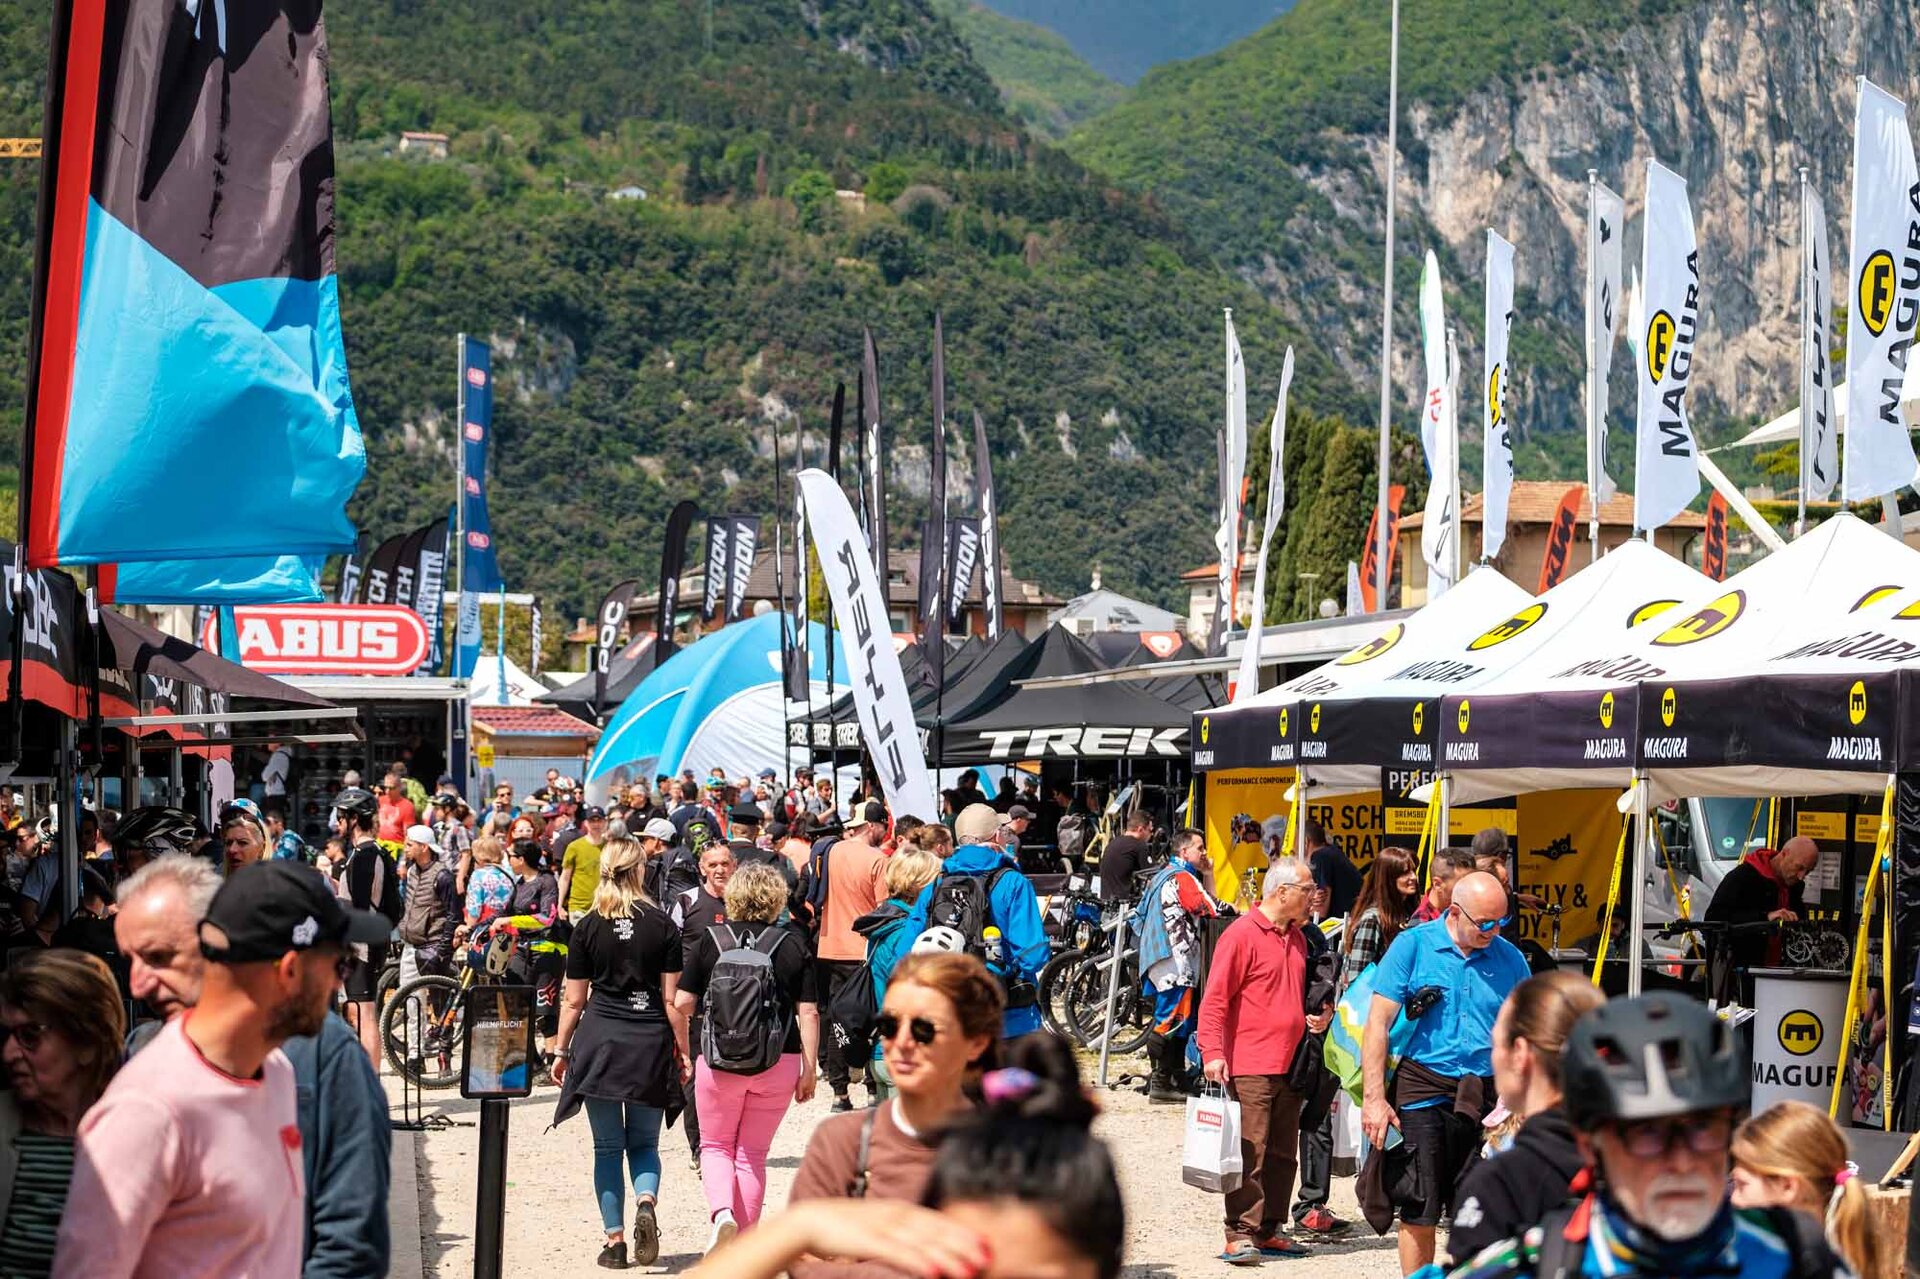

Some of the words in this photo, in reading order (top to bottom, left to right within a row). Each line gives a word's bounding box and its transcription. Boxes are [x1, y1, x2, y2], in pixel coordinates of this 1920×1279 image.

[1658, 249, 1699, 458] MAGURA
[1546, 506, 1575, 590] KTM
[240, 618, 399, 660] ABUS
[598, 600, 625, 675] POC
[1384, 660, 1485, 684] MAGURA
[1548, 654, 1666, 682] MAGUR
[836, 722, 860, 747] TREK
[979, 726, 1190, 758] TREK
[1194, 750, 1214, 766] MAGURA
[1271, 743, 1294, 762] MAGURA
[1301, 741, 1327, 758] MAGURA
[1402, 743, 1431, 761] MAGURA
[1446, 742, 1479, 761] MAGURA
[1584, 737, 1626, 760] MAGURA
[1643, 736, 1687, 760] MAGURA
[1826, 736, 1882, 761] MAGURA
[1216, 777, 1259, 786] PERFORMANCE
[1259, 775, 1297, 785] COMPONENT
[1300, 805, 1334, 830] ER
[1395, 810, 1426, 818] BREMSBE
[1572, 883, 1588, 908] &
[1752, 1061, 1851, 1088] MAGURA
